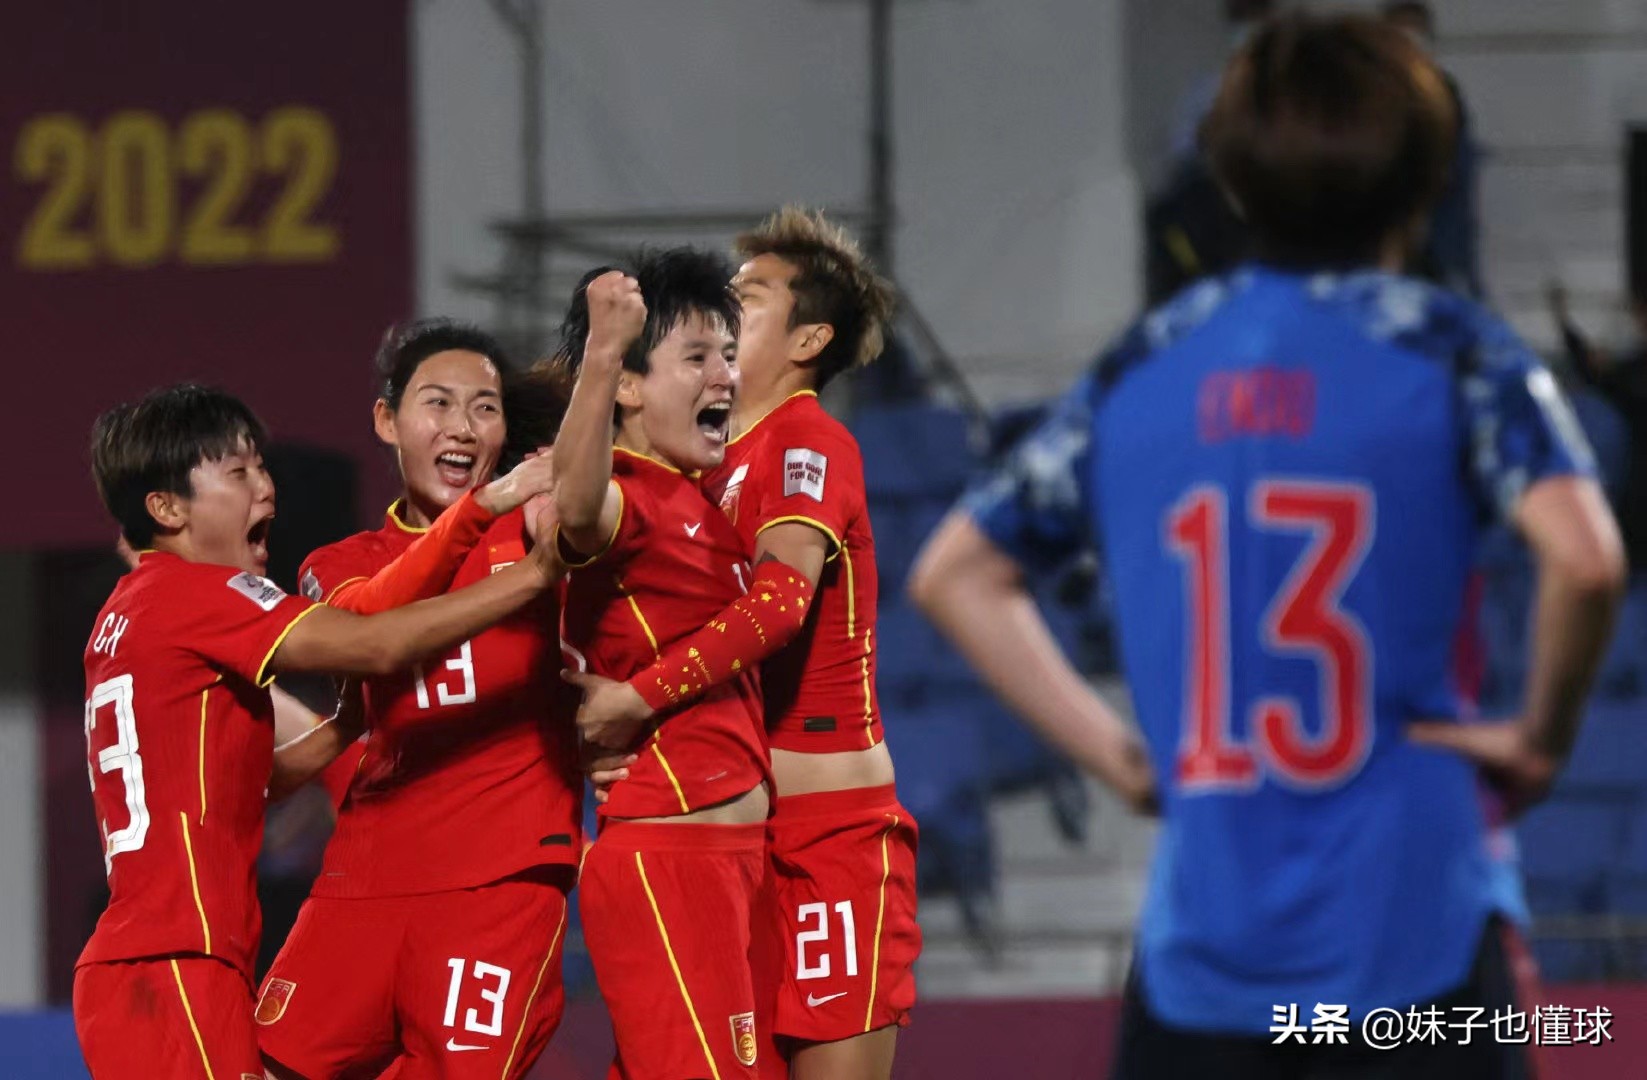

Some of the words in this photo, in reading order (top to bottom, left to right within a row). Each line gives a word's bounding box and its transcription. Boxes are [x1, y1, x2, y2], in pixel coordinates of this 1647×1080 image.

[16, 109, 338, 270] 2022
[1162, 482, 1374, 790] 13
[443, 957, 512, 1037] 13
[796, 900, 858, 980] 21
